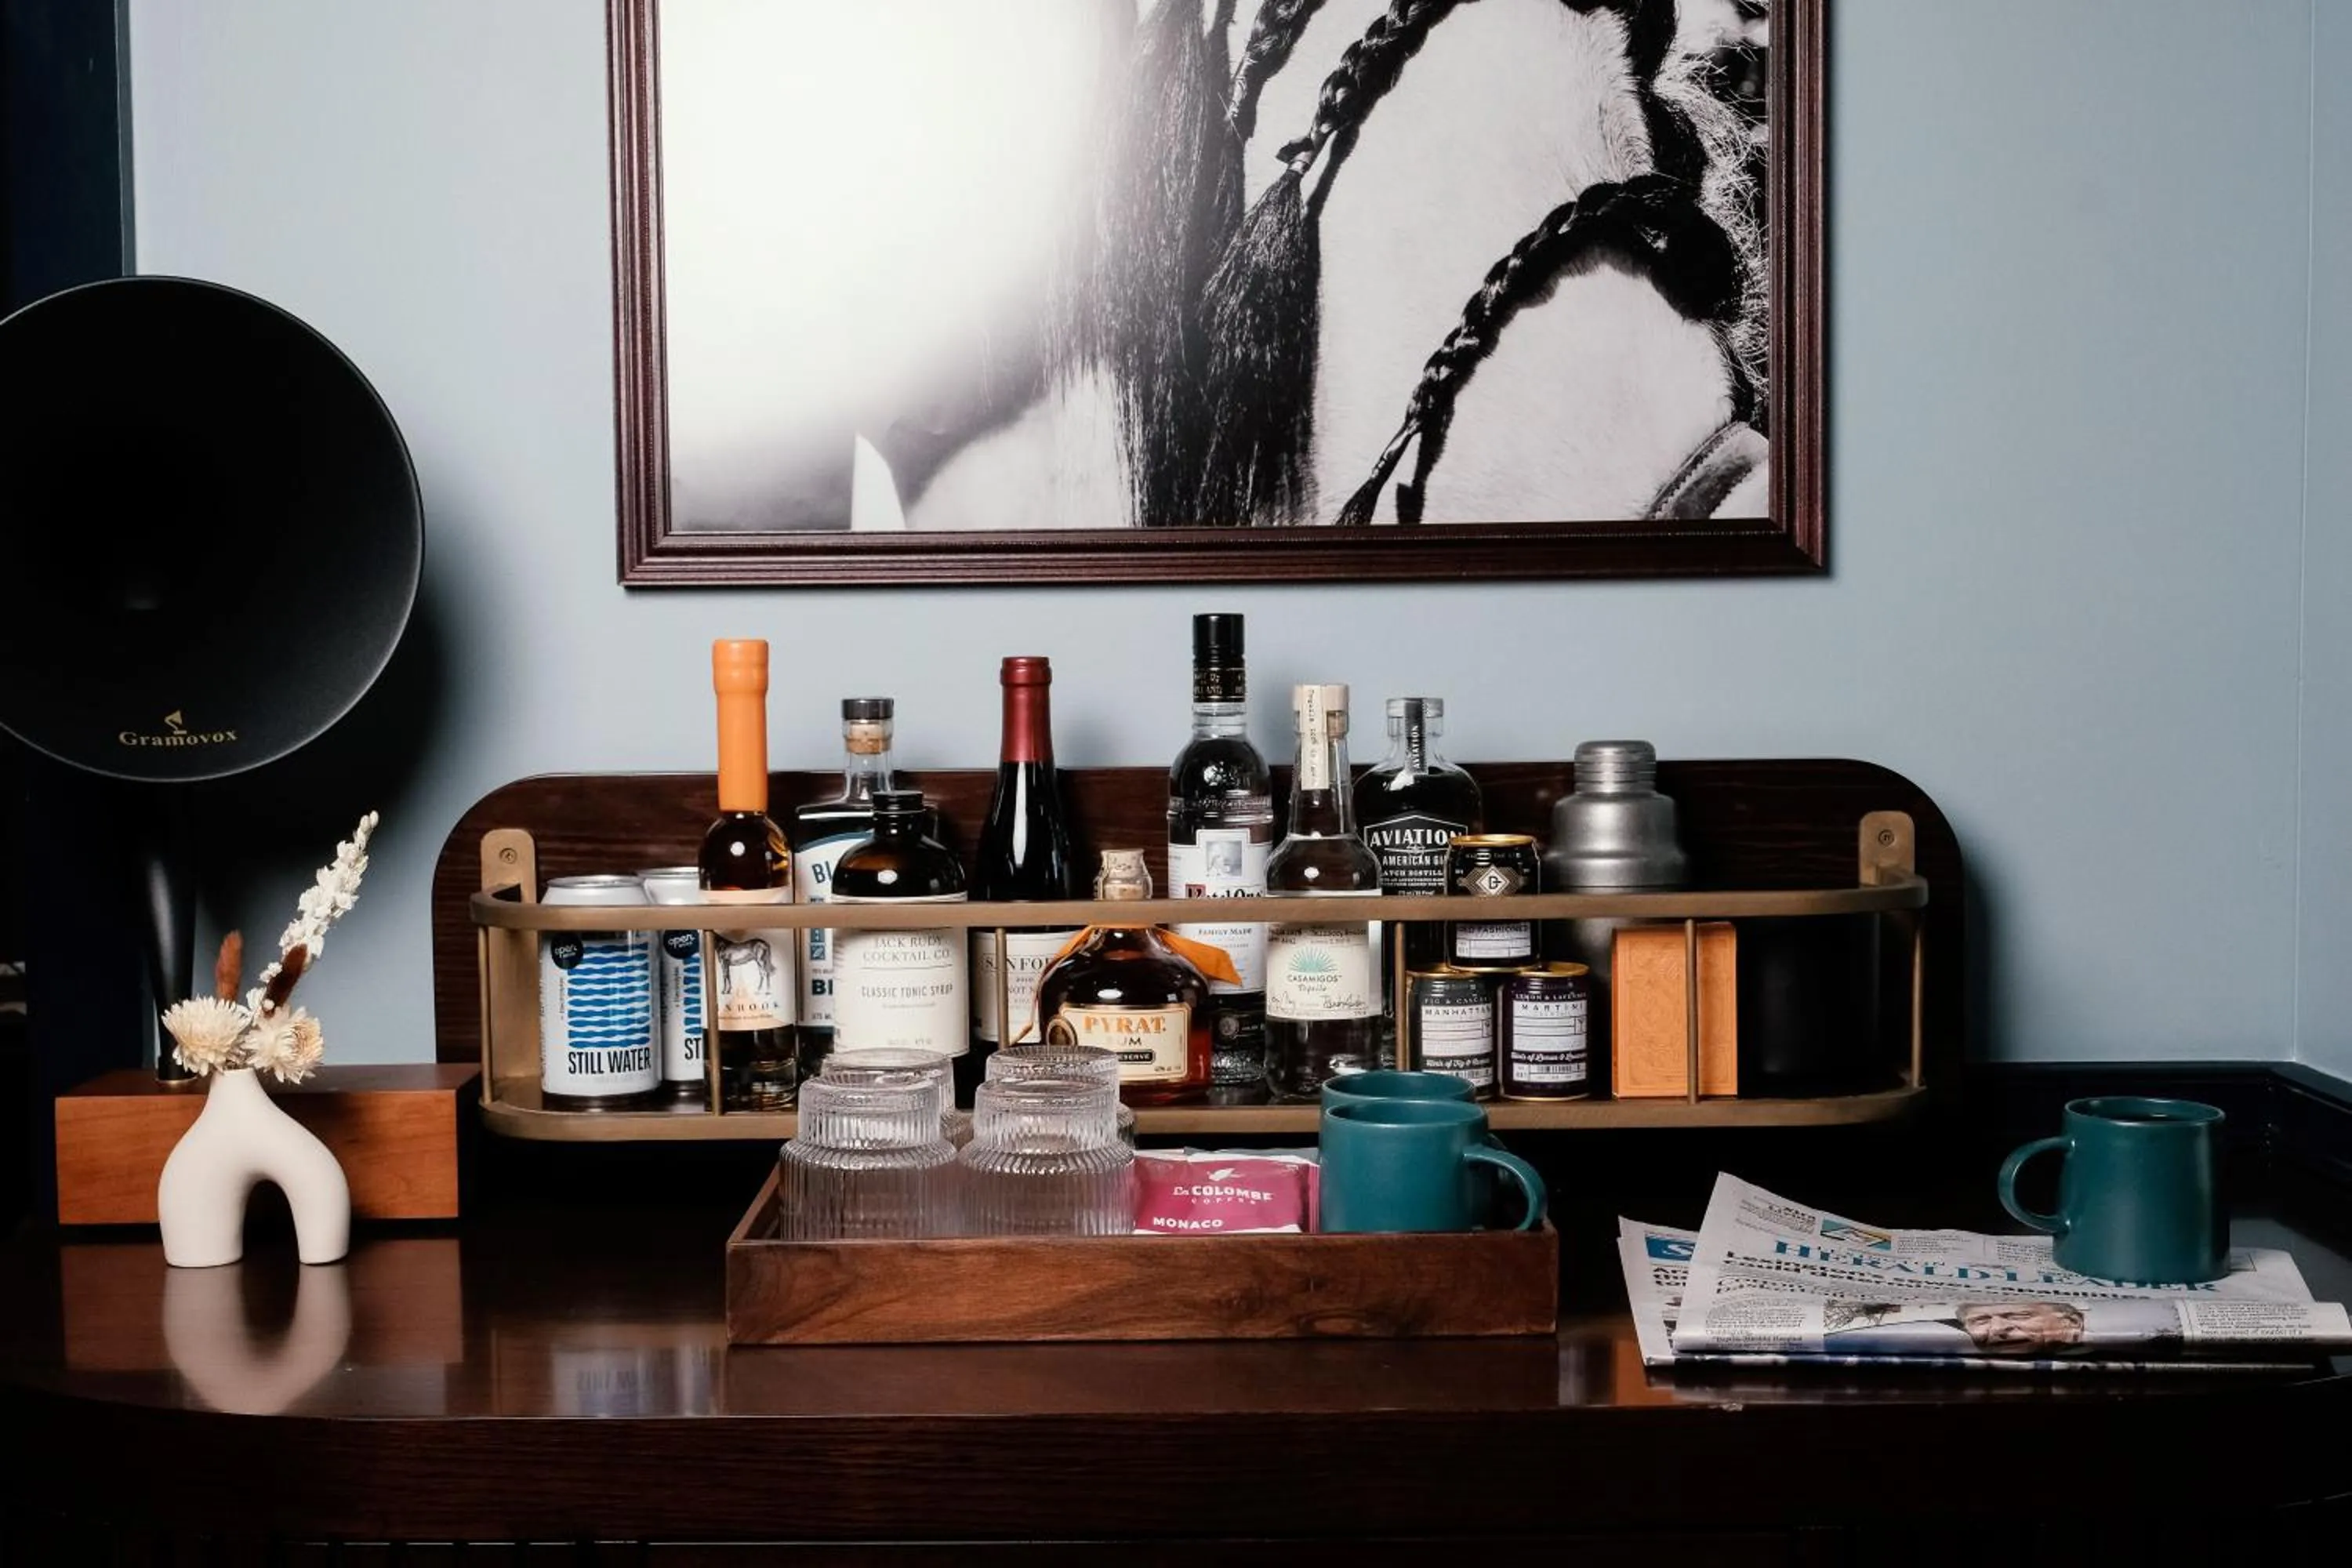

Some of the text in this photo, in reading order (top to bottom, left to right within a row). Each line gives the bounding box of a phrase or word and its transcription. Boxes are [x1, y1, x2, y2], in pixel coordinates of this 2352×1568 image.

[118, 730, 238, 746] Gramovox
[1410, 725, 1420, 769] AVIATION
[1382, 855, 1432, 866] AMERICAN
[668, 934, 695, 949] open
[875, 937, 906, 948] JACK
[863, 950, 929, 963] COCKTAIL
[862, 985, 898, 998] CLASSIC
[901, 985, 927, 999] TONIC
[1425, 1005, 1491, 1016] MANHATTAN
[1522, 1003, 1583, 1011] MARTINI
[568, 1047, 652, 1075] STILL WATER
[1192, 1185, 1273, 1201] COLOMBE
[1153, 1217, 1223, 1230] MONACO
